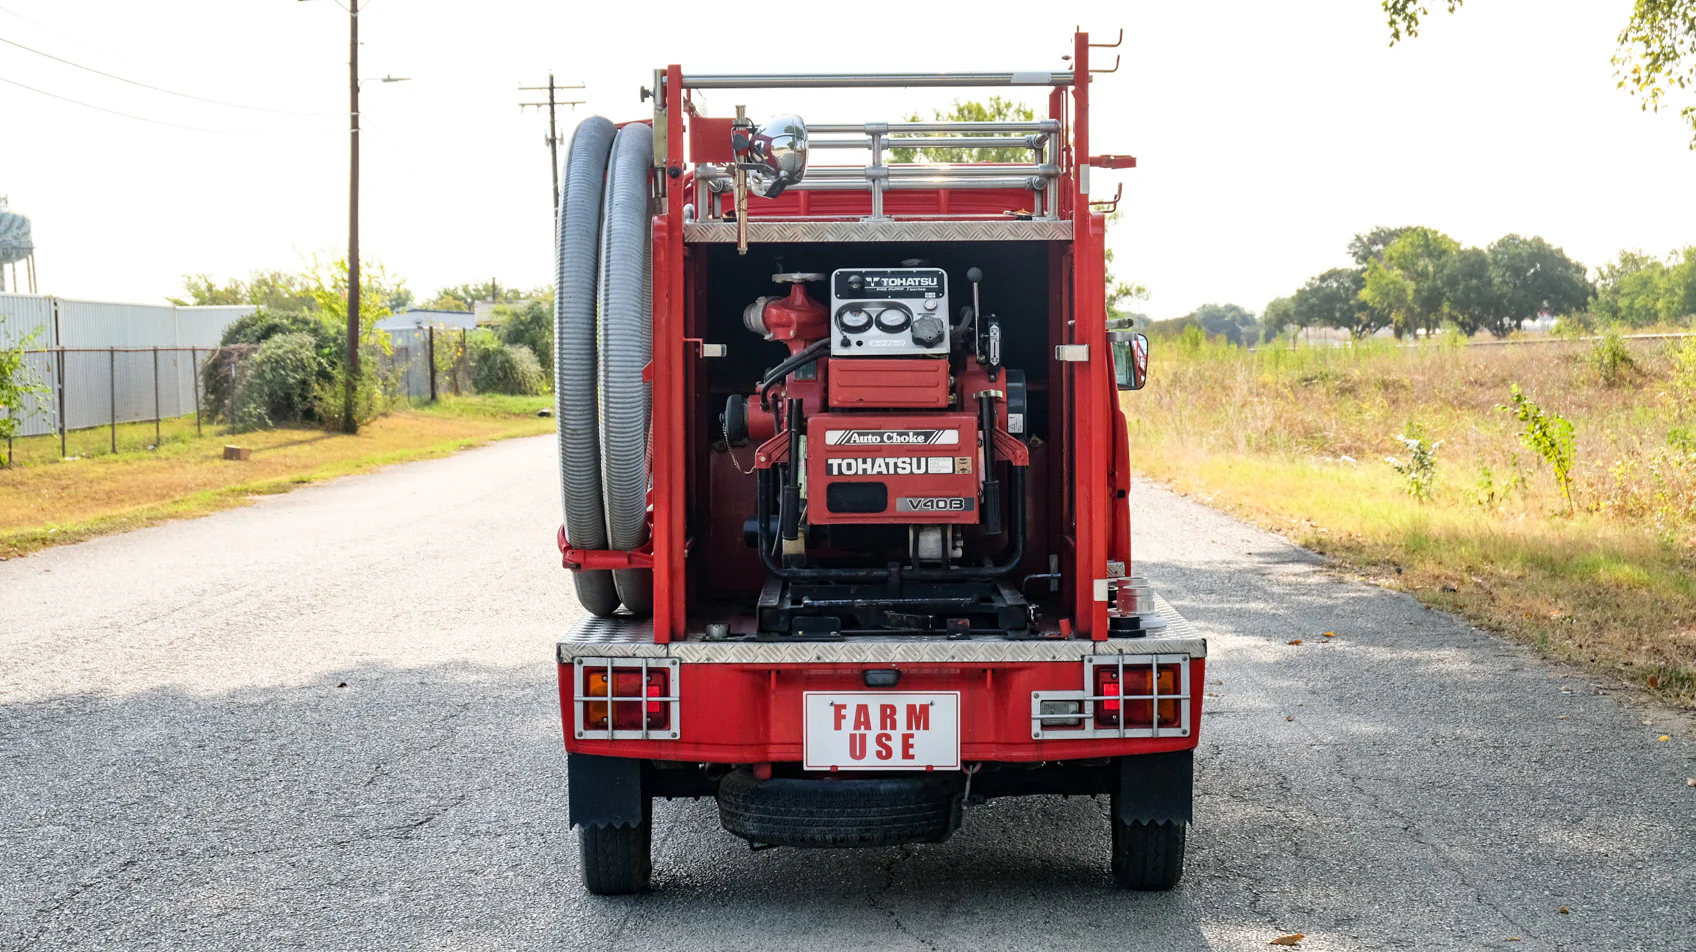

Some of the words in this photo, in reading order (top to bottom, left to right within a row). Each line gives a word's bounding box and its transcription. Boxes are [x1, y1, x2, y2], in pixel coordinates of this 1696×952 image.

[881, 277, 937, 286] TOHATSU
[850, 432, 880, 444] Auto
[883, 431, 925, 444] Choke
[827, 457, 926, 475] TOHATSU
[907, 497, 965, 511] V40B
[834, 704, 930, 731] FARM
[849, 732, 916, 761] USE
